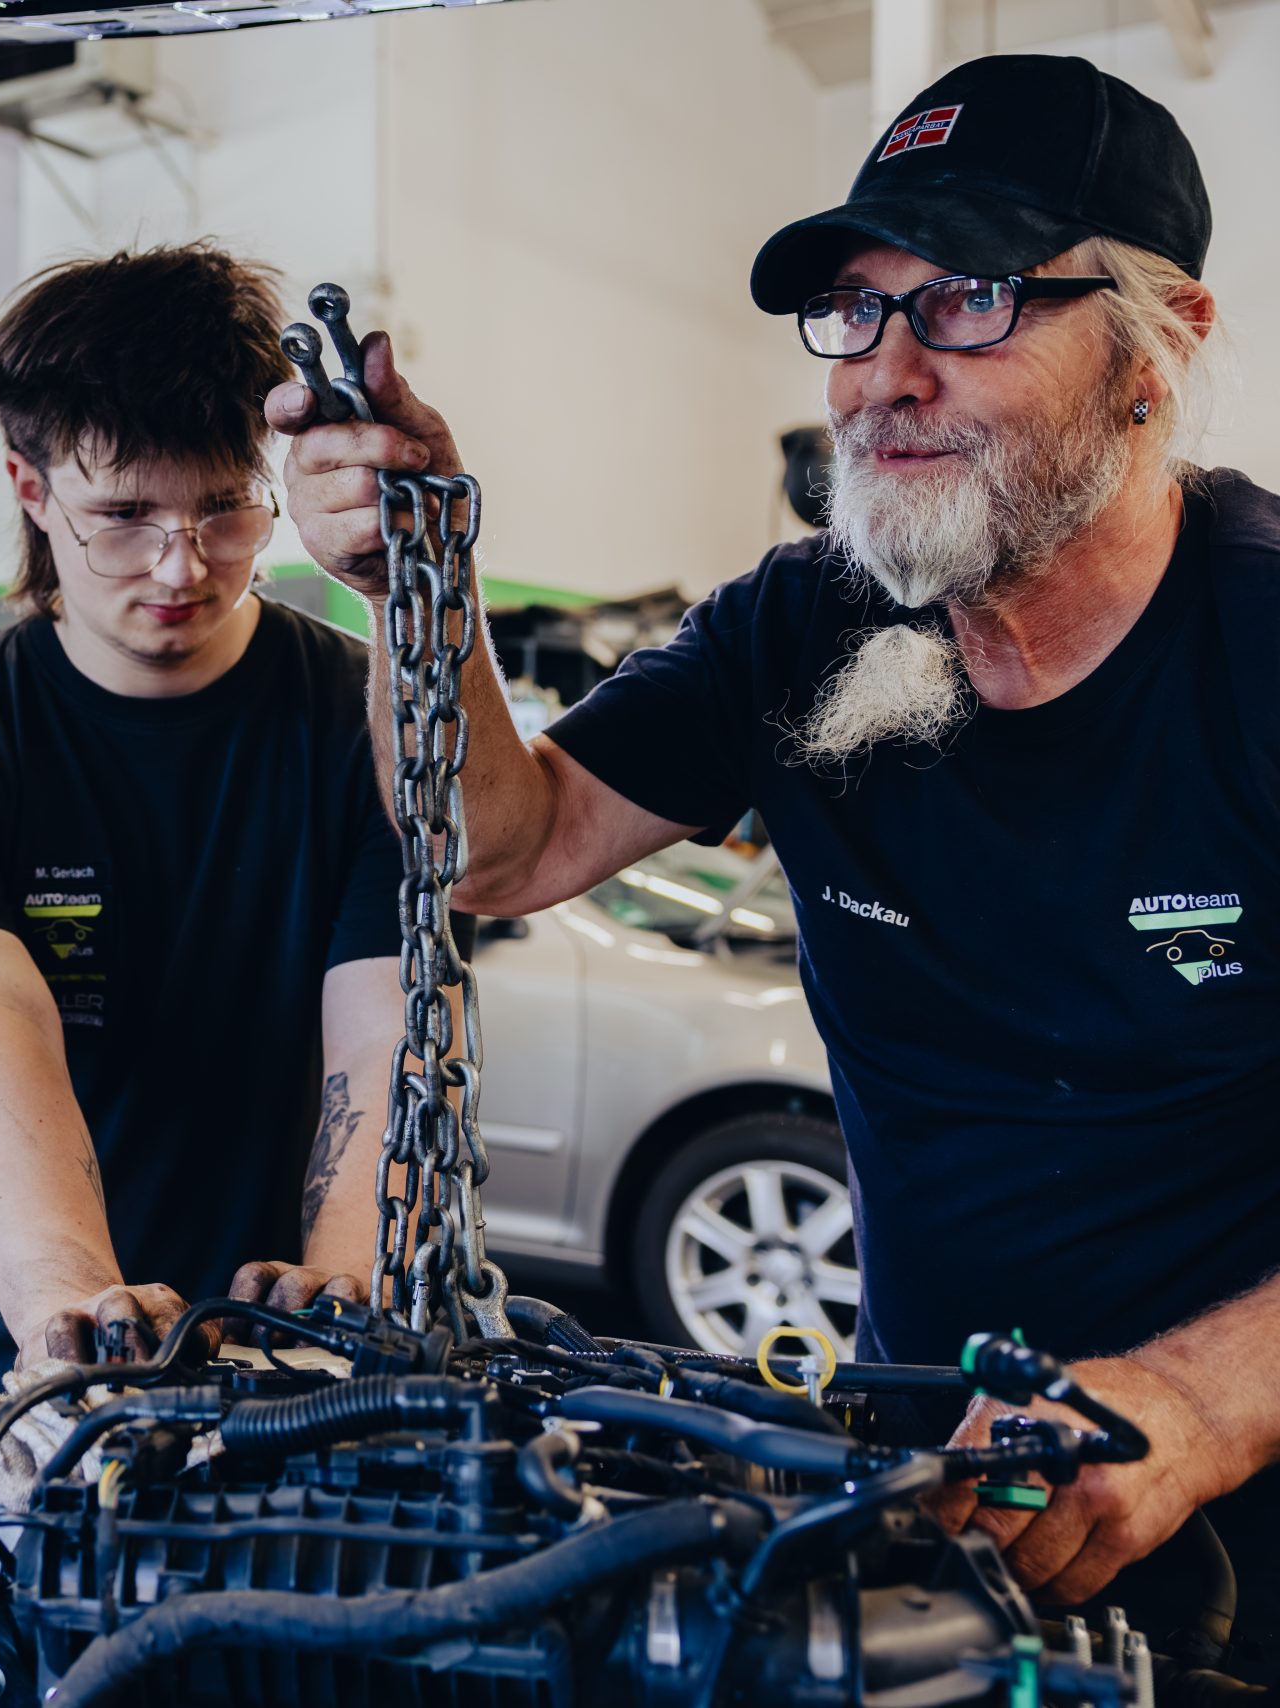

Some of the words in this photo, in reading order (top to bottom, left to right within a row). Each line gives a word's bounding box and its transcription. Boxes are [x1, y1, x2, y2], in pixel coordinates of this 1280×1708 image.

[35, 868, 49, 878] M.
[51, 866, 95, 878] Gerlach
[25, 893, 101, 905] AUTOteam
[822, 886, 836, 903] J.
[839, 891, 910, 927] Dackau
[1128, 893, 1240, 914] AUTOteam
[1198, 961, 1244, 983] plus
[59, 993, 104, 1010] LER
